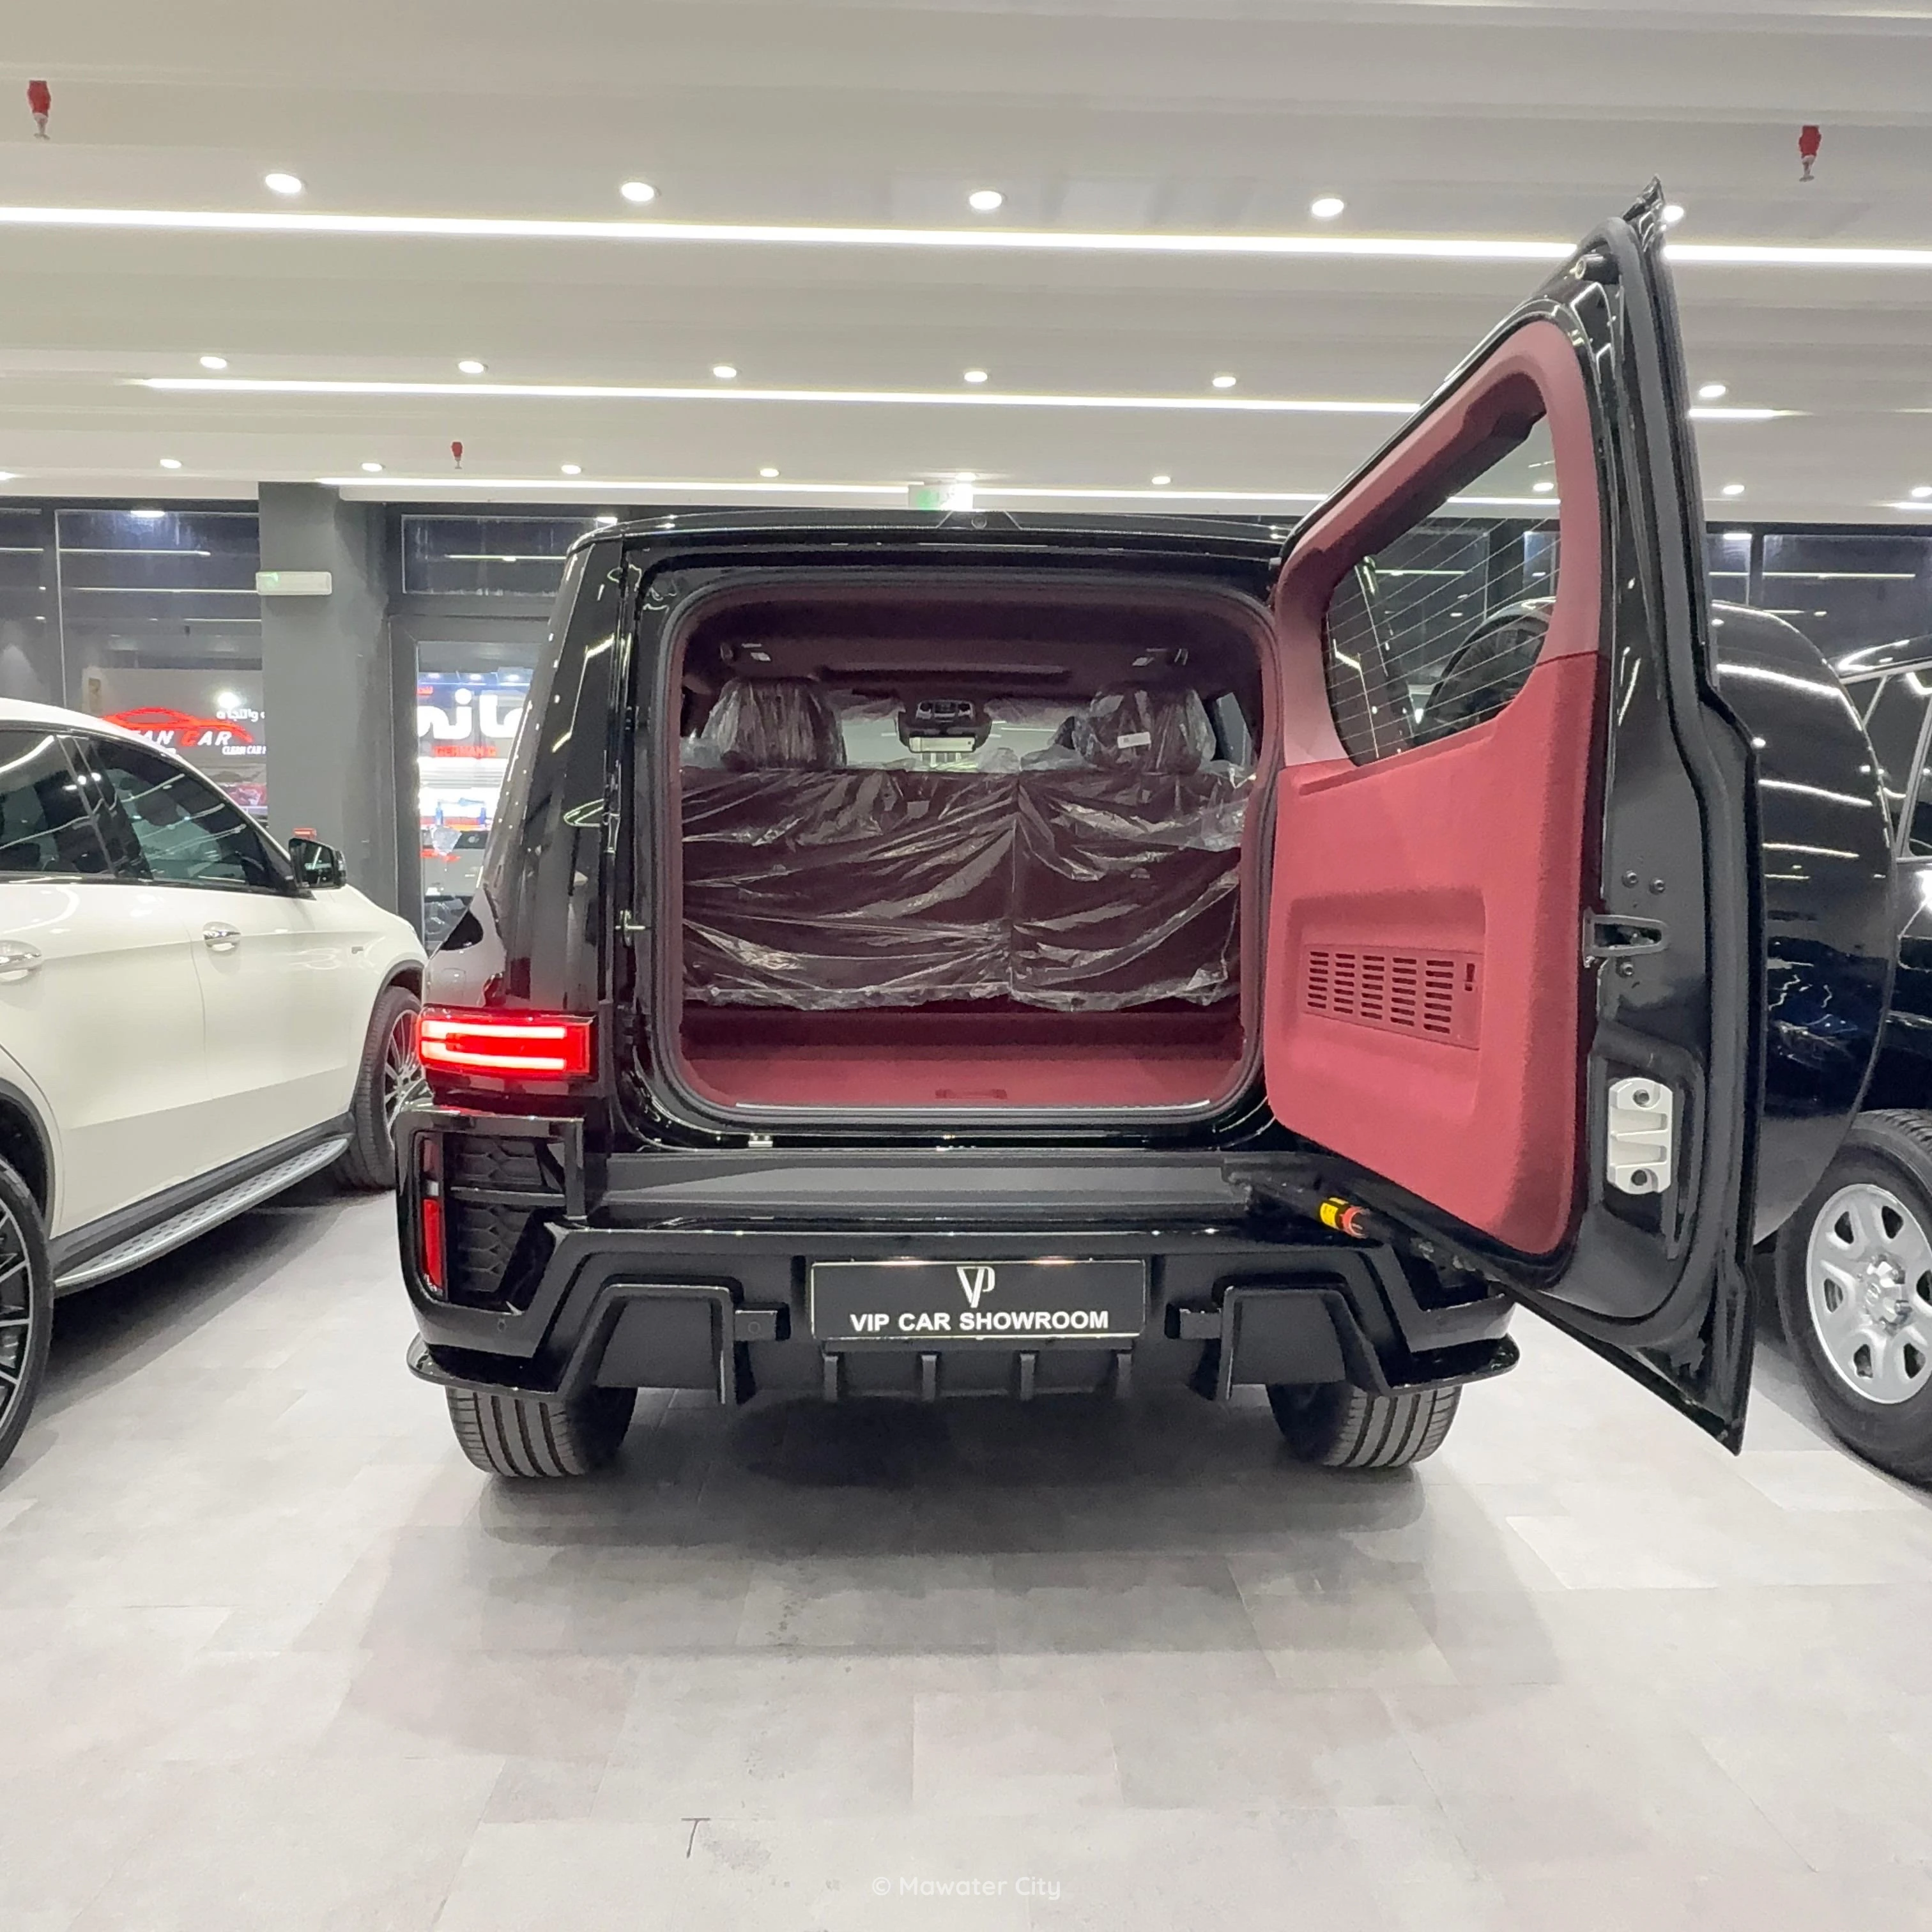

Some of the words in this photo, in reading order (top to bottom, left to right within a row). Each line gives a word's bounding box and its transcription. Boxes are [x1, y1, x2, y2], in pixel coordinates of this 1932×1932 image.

[180, 730, 233, 746] CAR
[850, 1314, 889, 1332] VIP
[898, 1313, 951, 1331] CAR
[960, 1311, 1108, 1331] SHOWROOM
